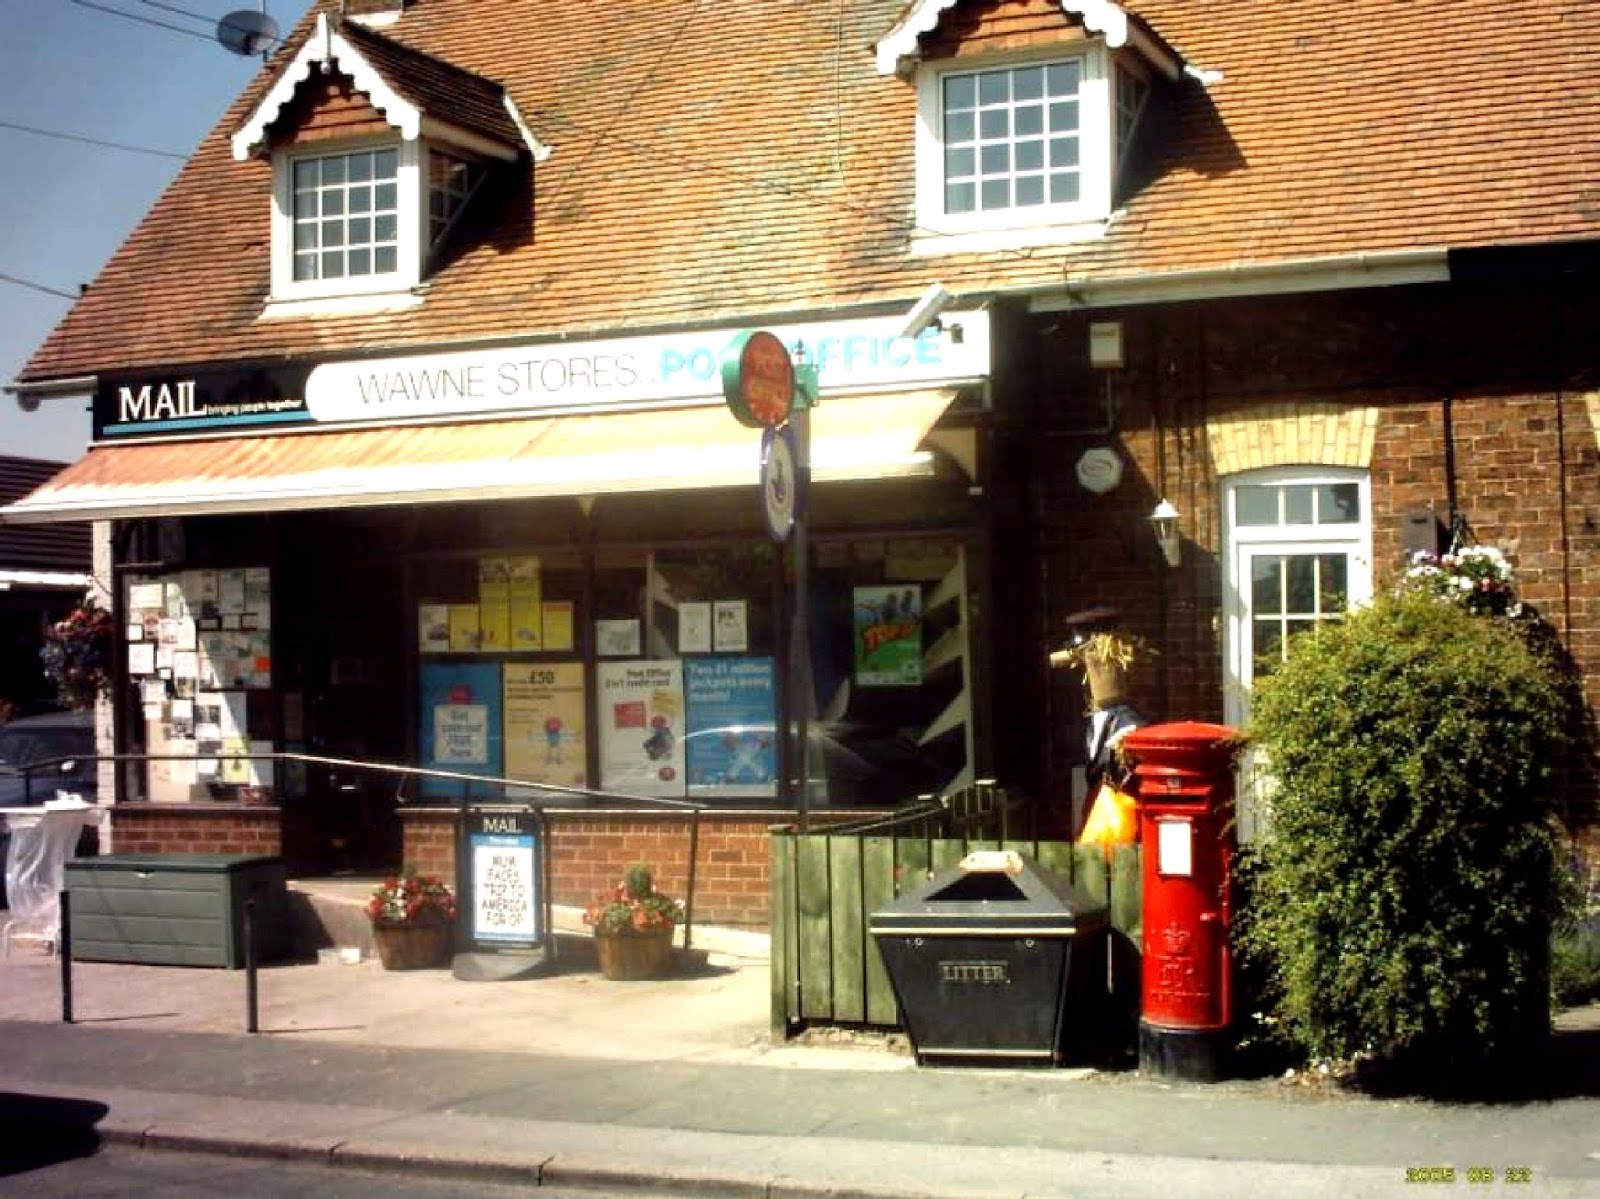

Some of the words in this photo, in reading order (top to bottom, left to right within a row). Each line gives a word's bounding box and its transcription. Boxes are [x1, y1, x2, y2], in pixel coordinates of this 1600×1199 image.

[357, 366, 484, 404] WAWNE
[117, 379, 207, 422] MAIL
[529, 671, 555, 685] £50
[483, 816, 523, 833] MAIL
[509, 883, 526, 898] TO
[481, 896, 528, 912] AMERICA
[942, 965, 1004, 982] LITTER
